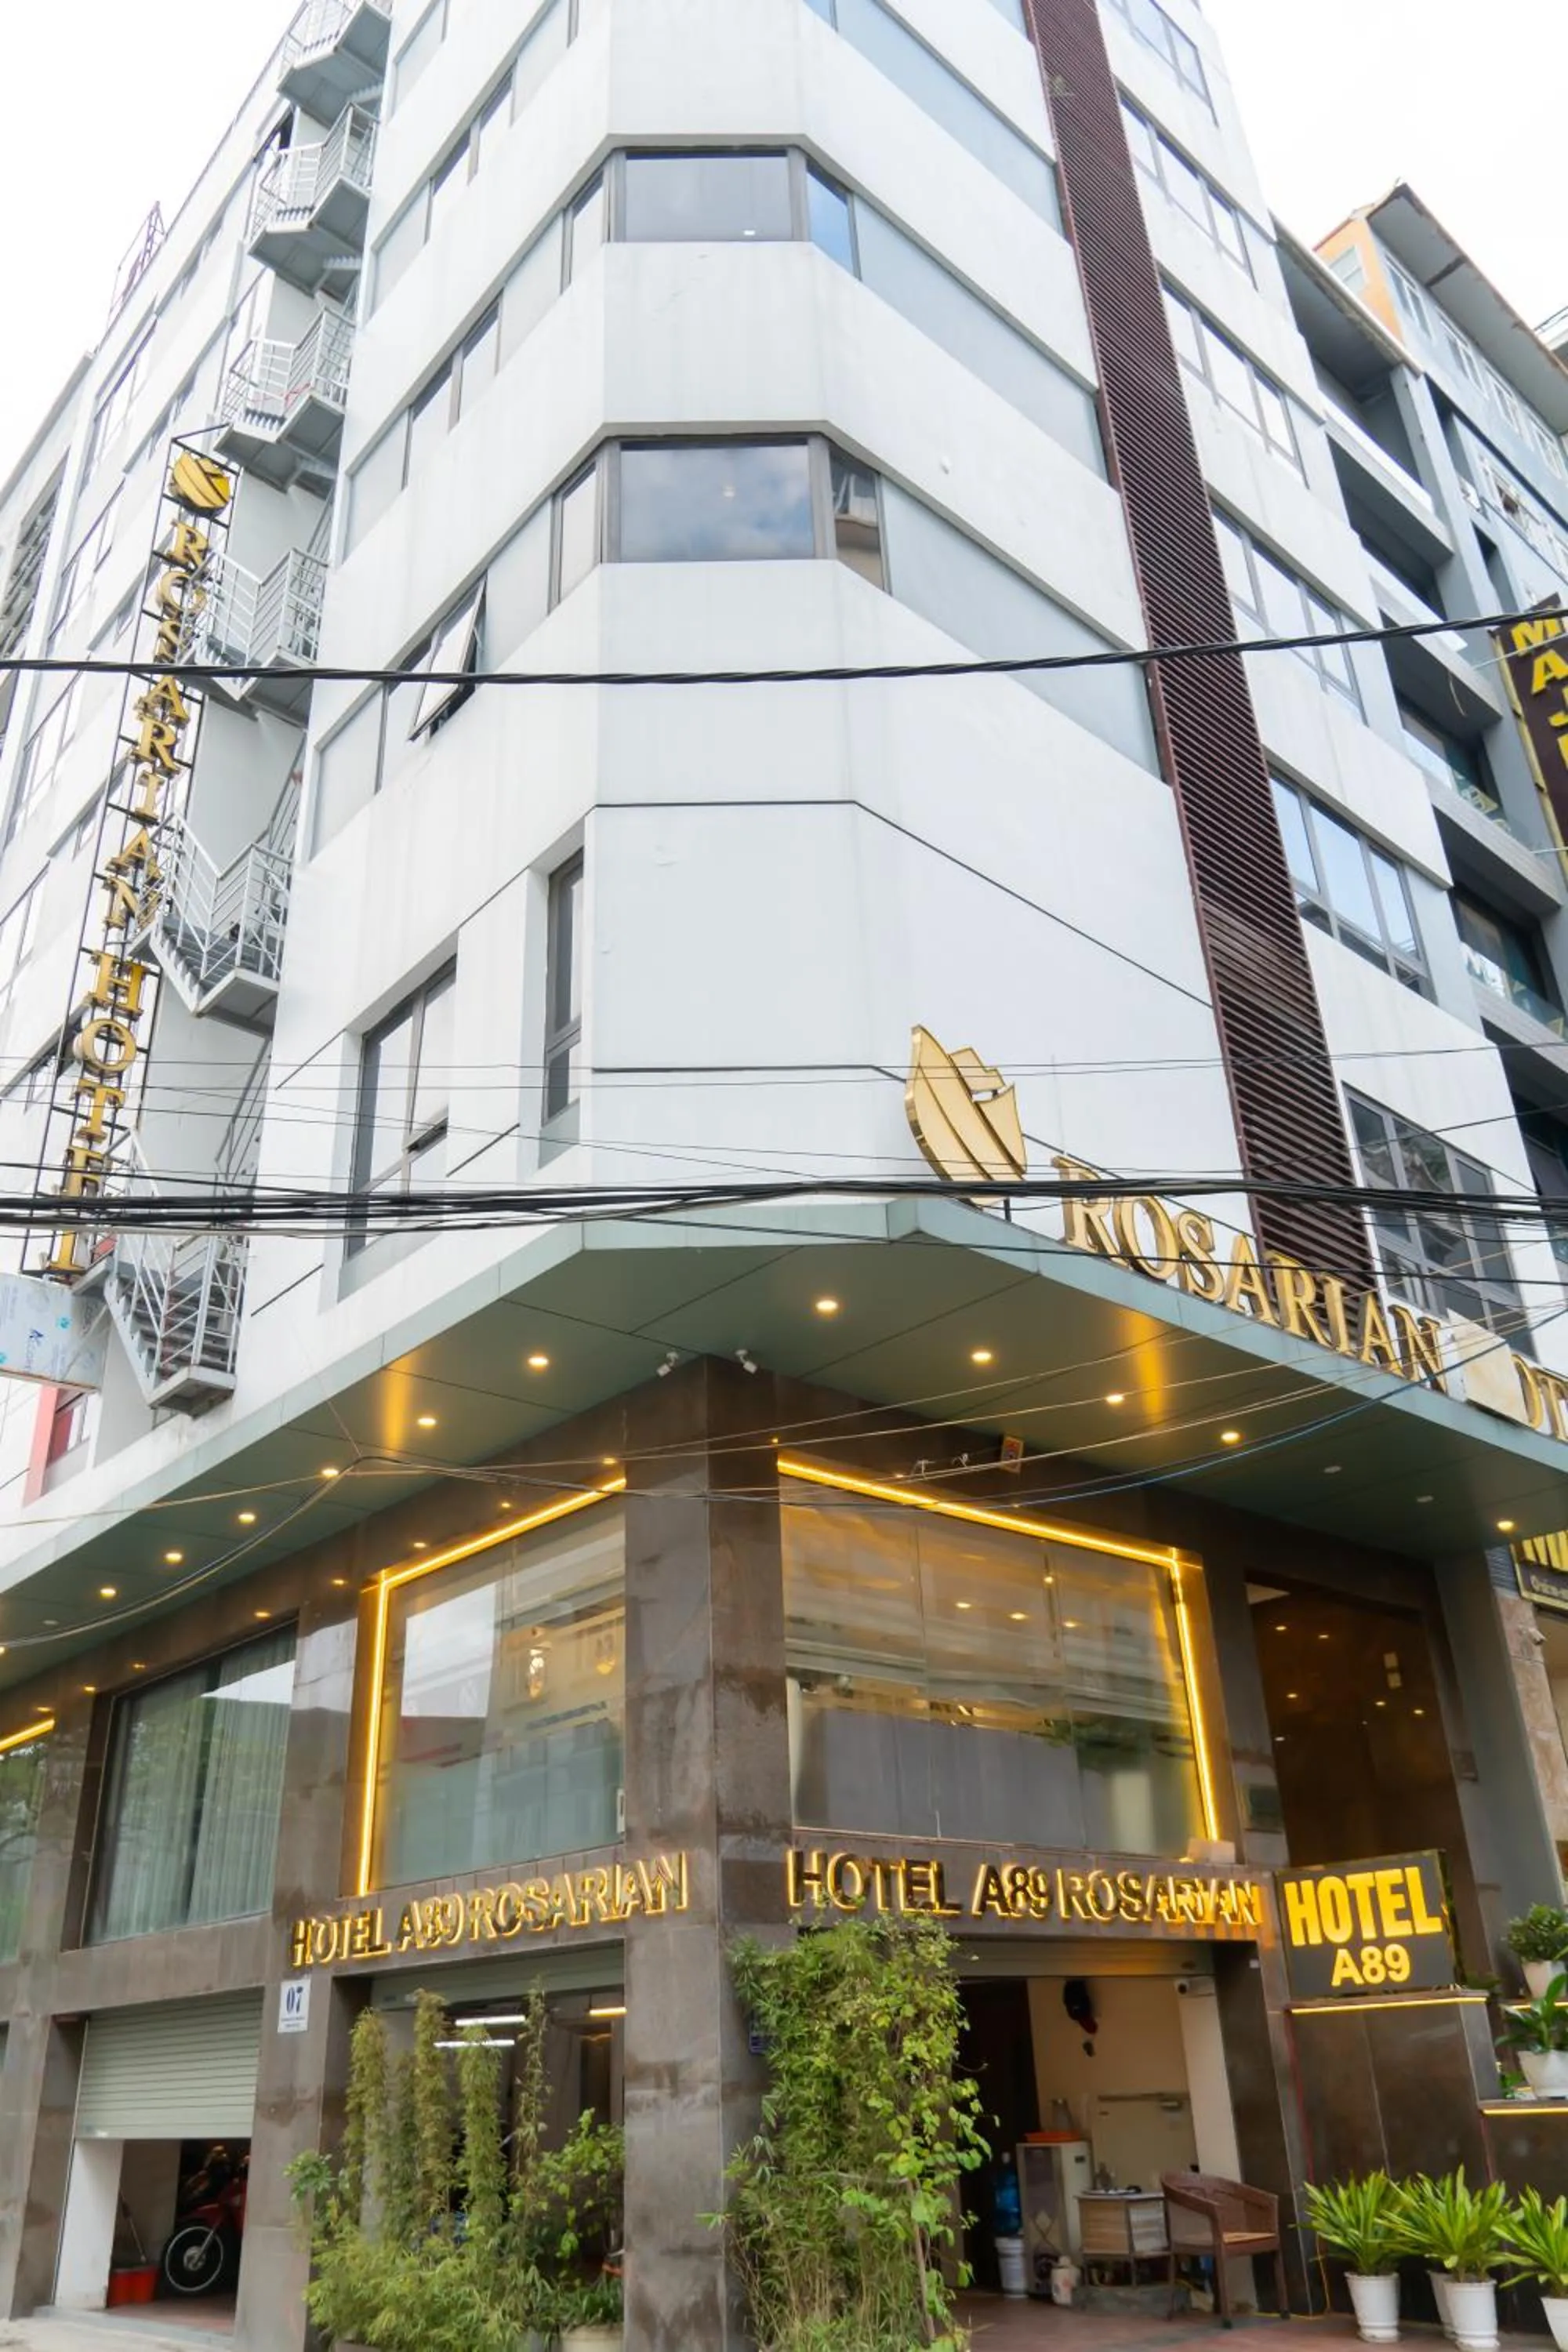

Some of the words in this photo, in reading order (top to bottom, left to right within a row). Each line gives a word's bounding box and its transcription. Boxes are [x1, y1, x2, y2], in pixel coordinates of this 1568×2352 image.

[1051, 1155, 1449, 1395] ROSARIAN
[292, 1907, 392, 1966] HOTEL
[469, 1851, 688, 1941] ROSARIAN
[786, 1849, 962, 1915] HOTEL
[971, 1863, 1051, 1918] A89
[1057, 1868, 1264, 1926] ROSARIAN
[1284, 1866, 1443, 1946] HOTEL
[286, 1986, 303, 2014] 07
[1331, 1944, 1410, 1986] A89
